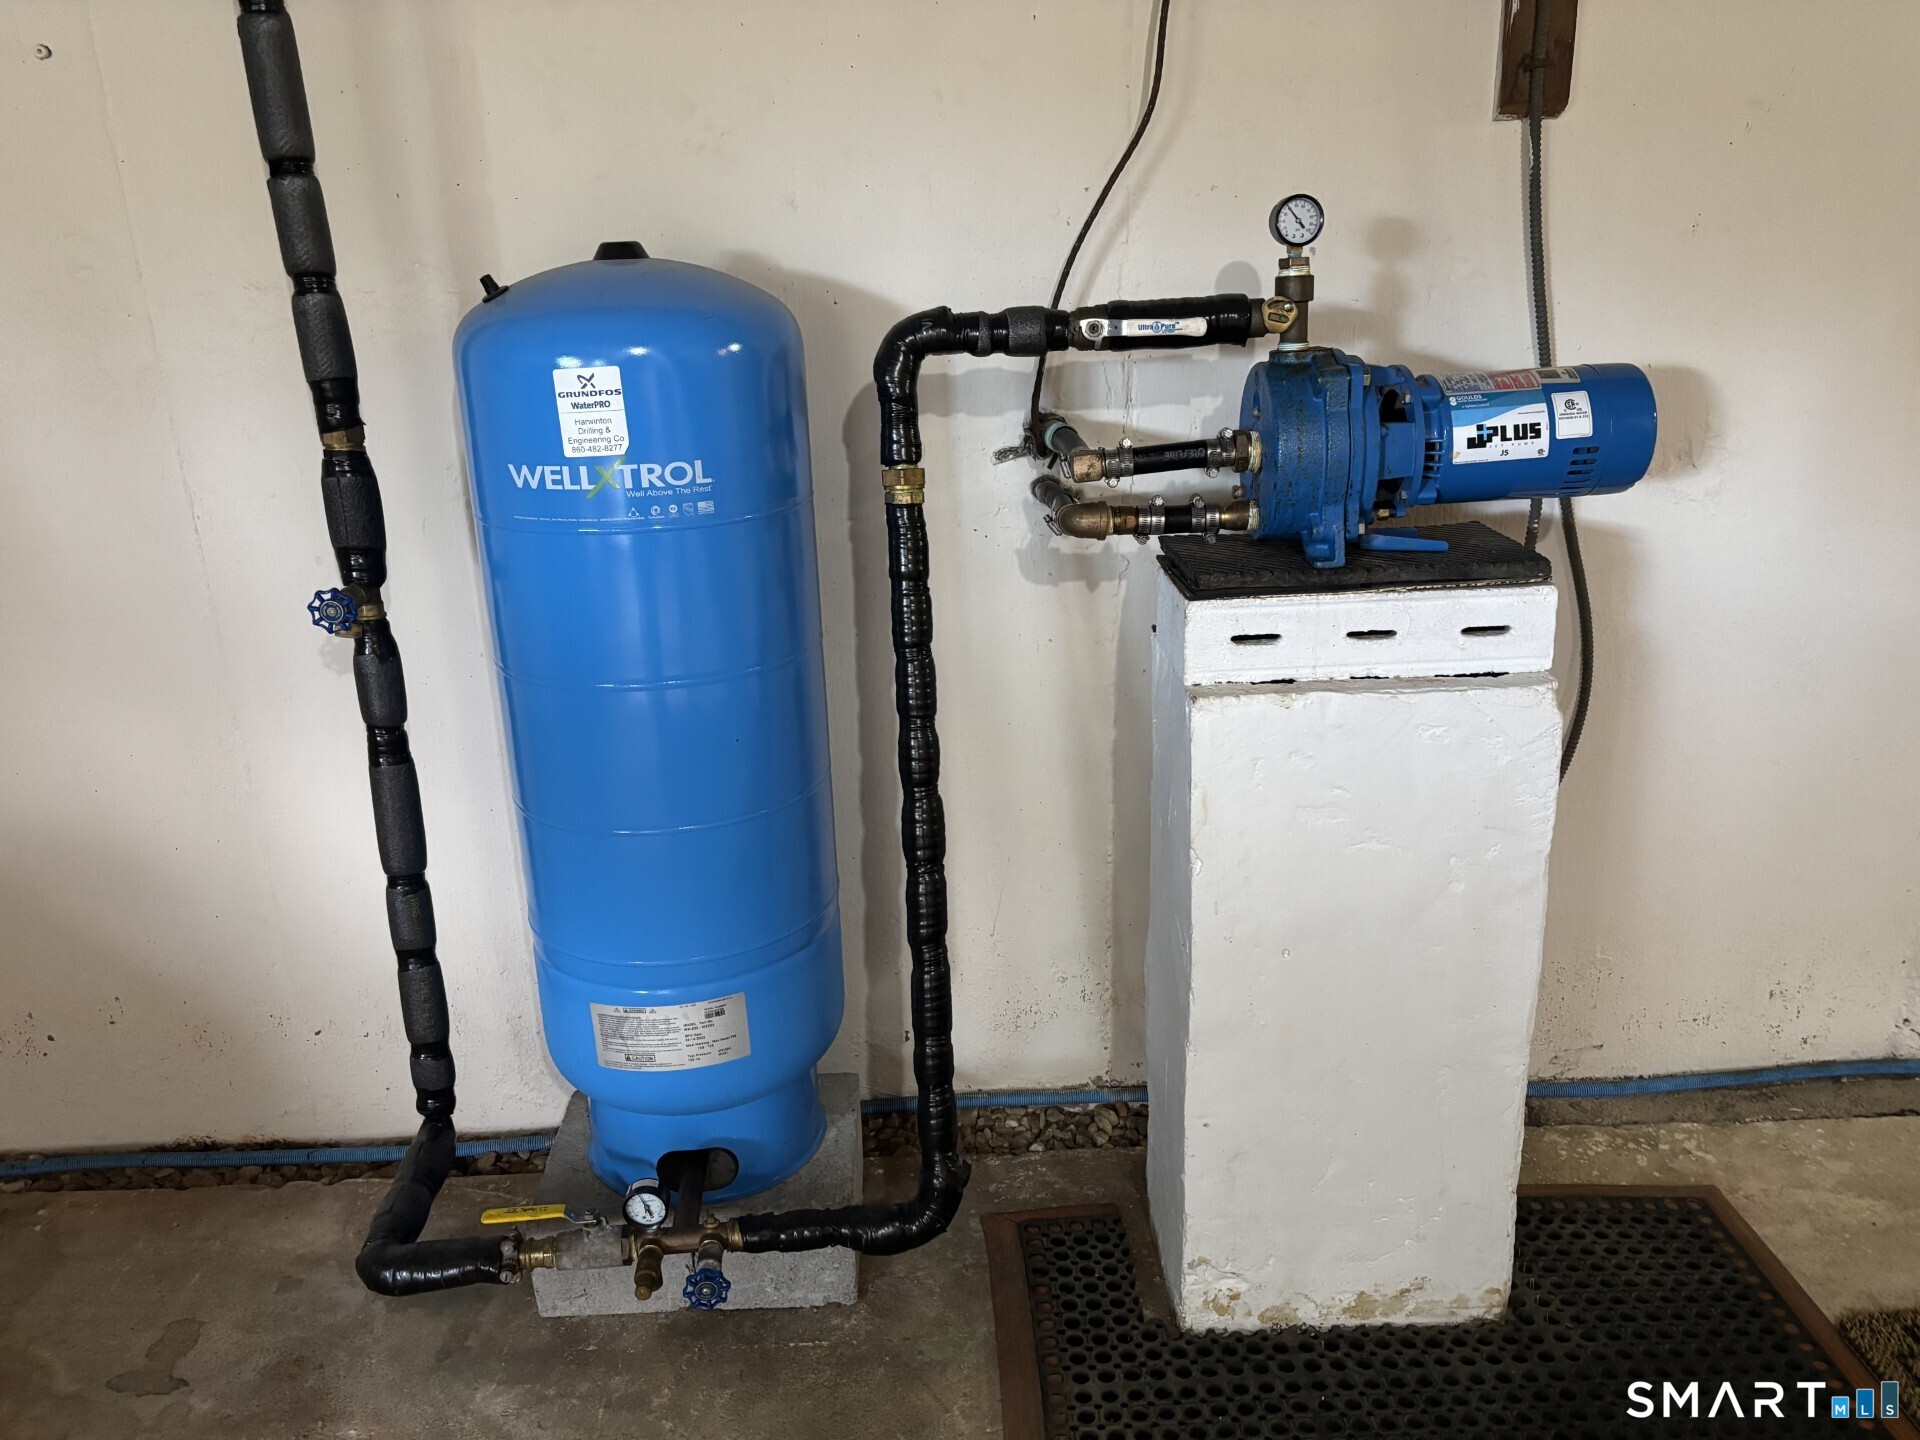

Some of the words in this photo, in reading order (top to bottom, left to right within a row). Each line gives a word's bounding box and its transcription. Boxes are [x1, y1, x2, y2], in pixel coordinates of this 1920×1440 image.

[557, 388, 622, 398] GRUNDFOS
[571, 400, 611, 410] WaterPRO
[574, 418, 612, 426] Harwinton
[577, 427, 603, 435] Drilling
[568, 436, 612, 446] Engineering
[626, 490, 645, 498] Well
[646, 489, 673, 497] Above
[675, 487, 691, 495] The
[693, 485, 712, 493] Rest
